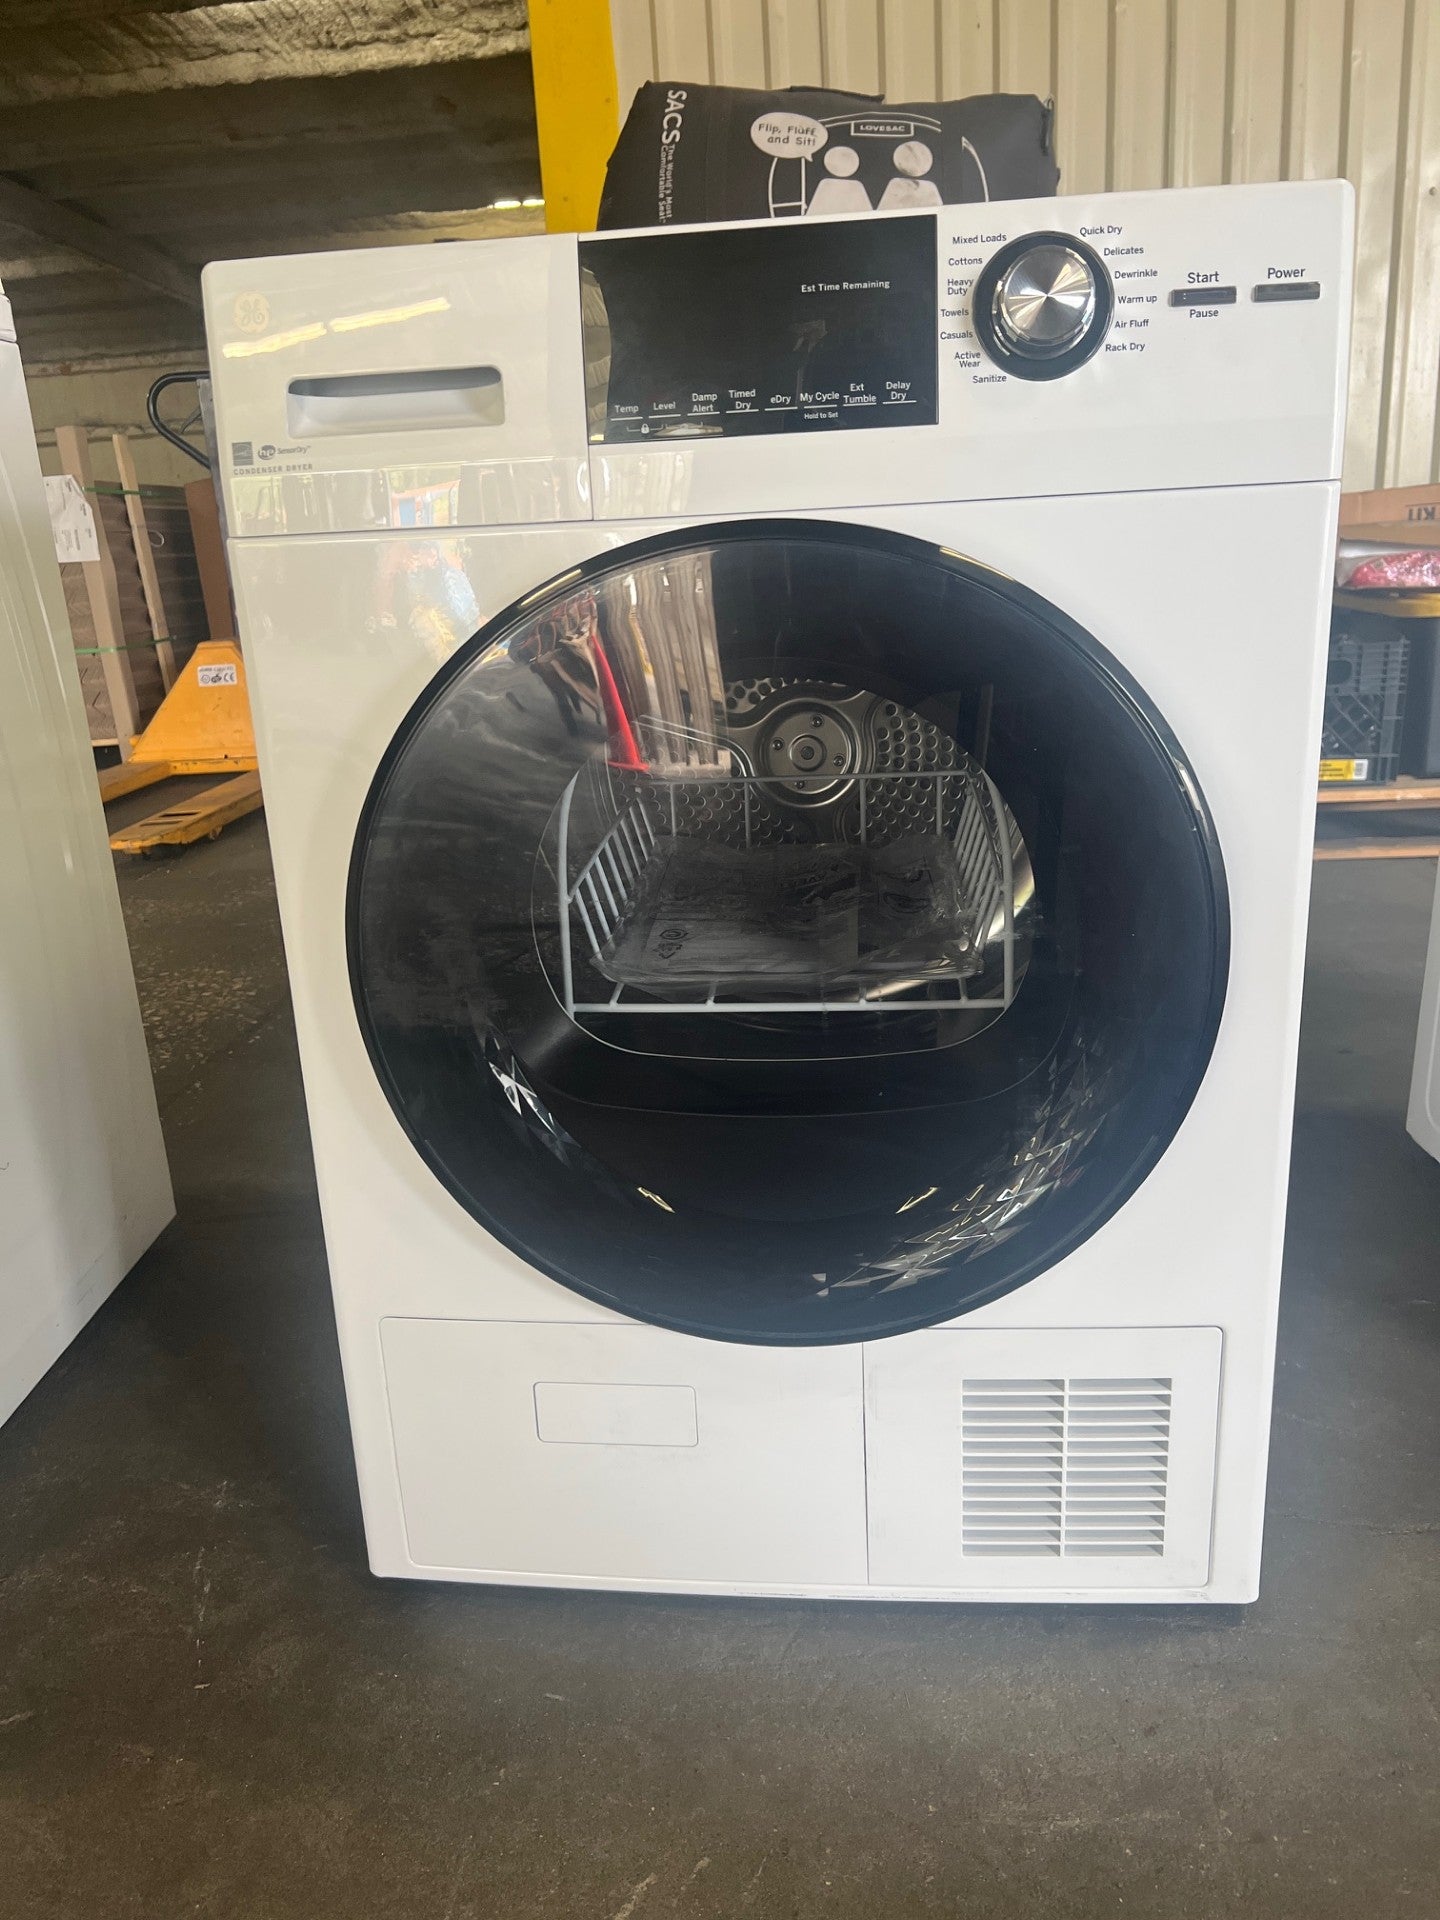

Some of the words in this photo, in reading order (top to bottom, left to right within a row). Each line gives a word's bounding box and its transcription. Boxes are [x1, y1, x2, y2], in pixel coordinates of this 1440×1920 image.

[662, 90, 688, 144] SACS
[758, 123, 782, 134] Flip,
[787, 125, 817, 136] Fluff
[859, 124, 906, 132] LOVESAC
[767, 135, 790, 144] and
[659, 145, 668, 199] Comfortable
[665, 196, 673, 218] Most
[1080, 226, 1105, 237] Quick
[1107, 226, 1122, 235] Dry
[952, 235, 978, 245] Mixed
[980, 233, 1007, 243] Loads
[1104, 246, 1144, 256] Delicates
[948, 257, 983, 266] Cottons
[1114, 269, 1158, 279] Dewrinkle
[1187, 271, 1220, 284] Start
[1267, 267, 1306, 279] Power
[801, 284, 816, 293] Est
[818, 283, 840, 292] Time
[842, 281, 890, 290] Remaining
[947, 278, 974, 287] Heavy
[947, 287, 968, 296] Duty
[1117, 296, 1144, 304] Warm
[1146, 295, 1157, 304] up
[940, 308, 969, 317] Towels
[1189, 309, 1219, 318] Pause
[1114, 320, 1127, 329] Air
[1129, 319, 1149, 328] Fluff
[940, 330, 973, 340] Casuals
[1105, 343, 1127, 352] Rack
[1129, 342, 1145, 352] Dry
[954, 351, 981, 360] Active
[959, 359, 980, 368] Wear
[972, 374, 1007, 384] Sanitize
[850, 383, 864, 392] Ext
[886, 381, 911, 391] Delay
[691, 393, 718, 402] Damp
[728, 389, 756, 399] Timed
[770, 394, 792, 404] eDry
[800, 392, 814, 403] My
[815, 391, 840, 402] Cycle
[843, 394, 877, 404] Tumble
[890, 391, 907, 401] Dry
[614, 405, 639, 414] Temp
[653, 401, 676, 411] Level
[692, 404, 714, 413] Alert
[735, 401, 751, 411] Dry
[804, 412, 819, 420] Hold
[233, 466, 282, 475] CONDENSER
[286, 464, 313, 472] DRYER
